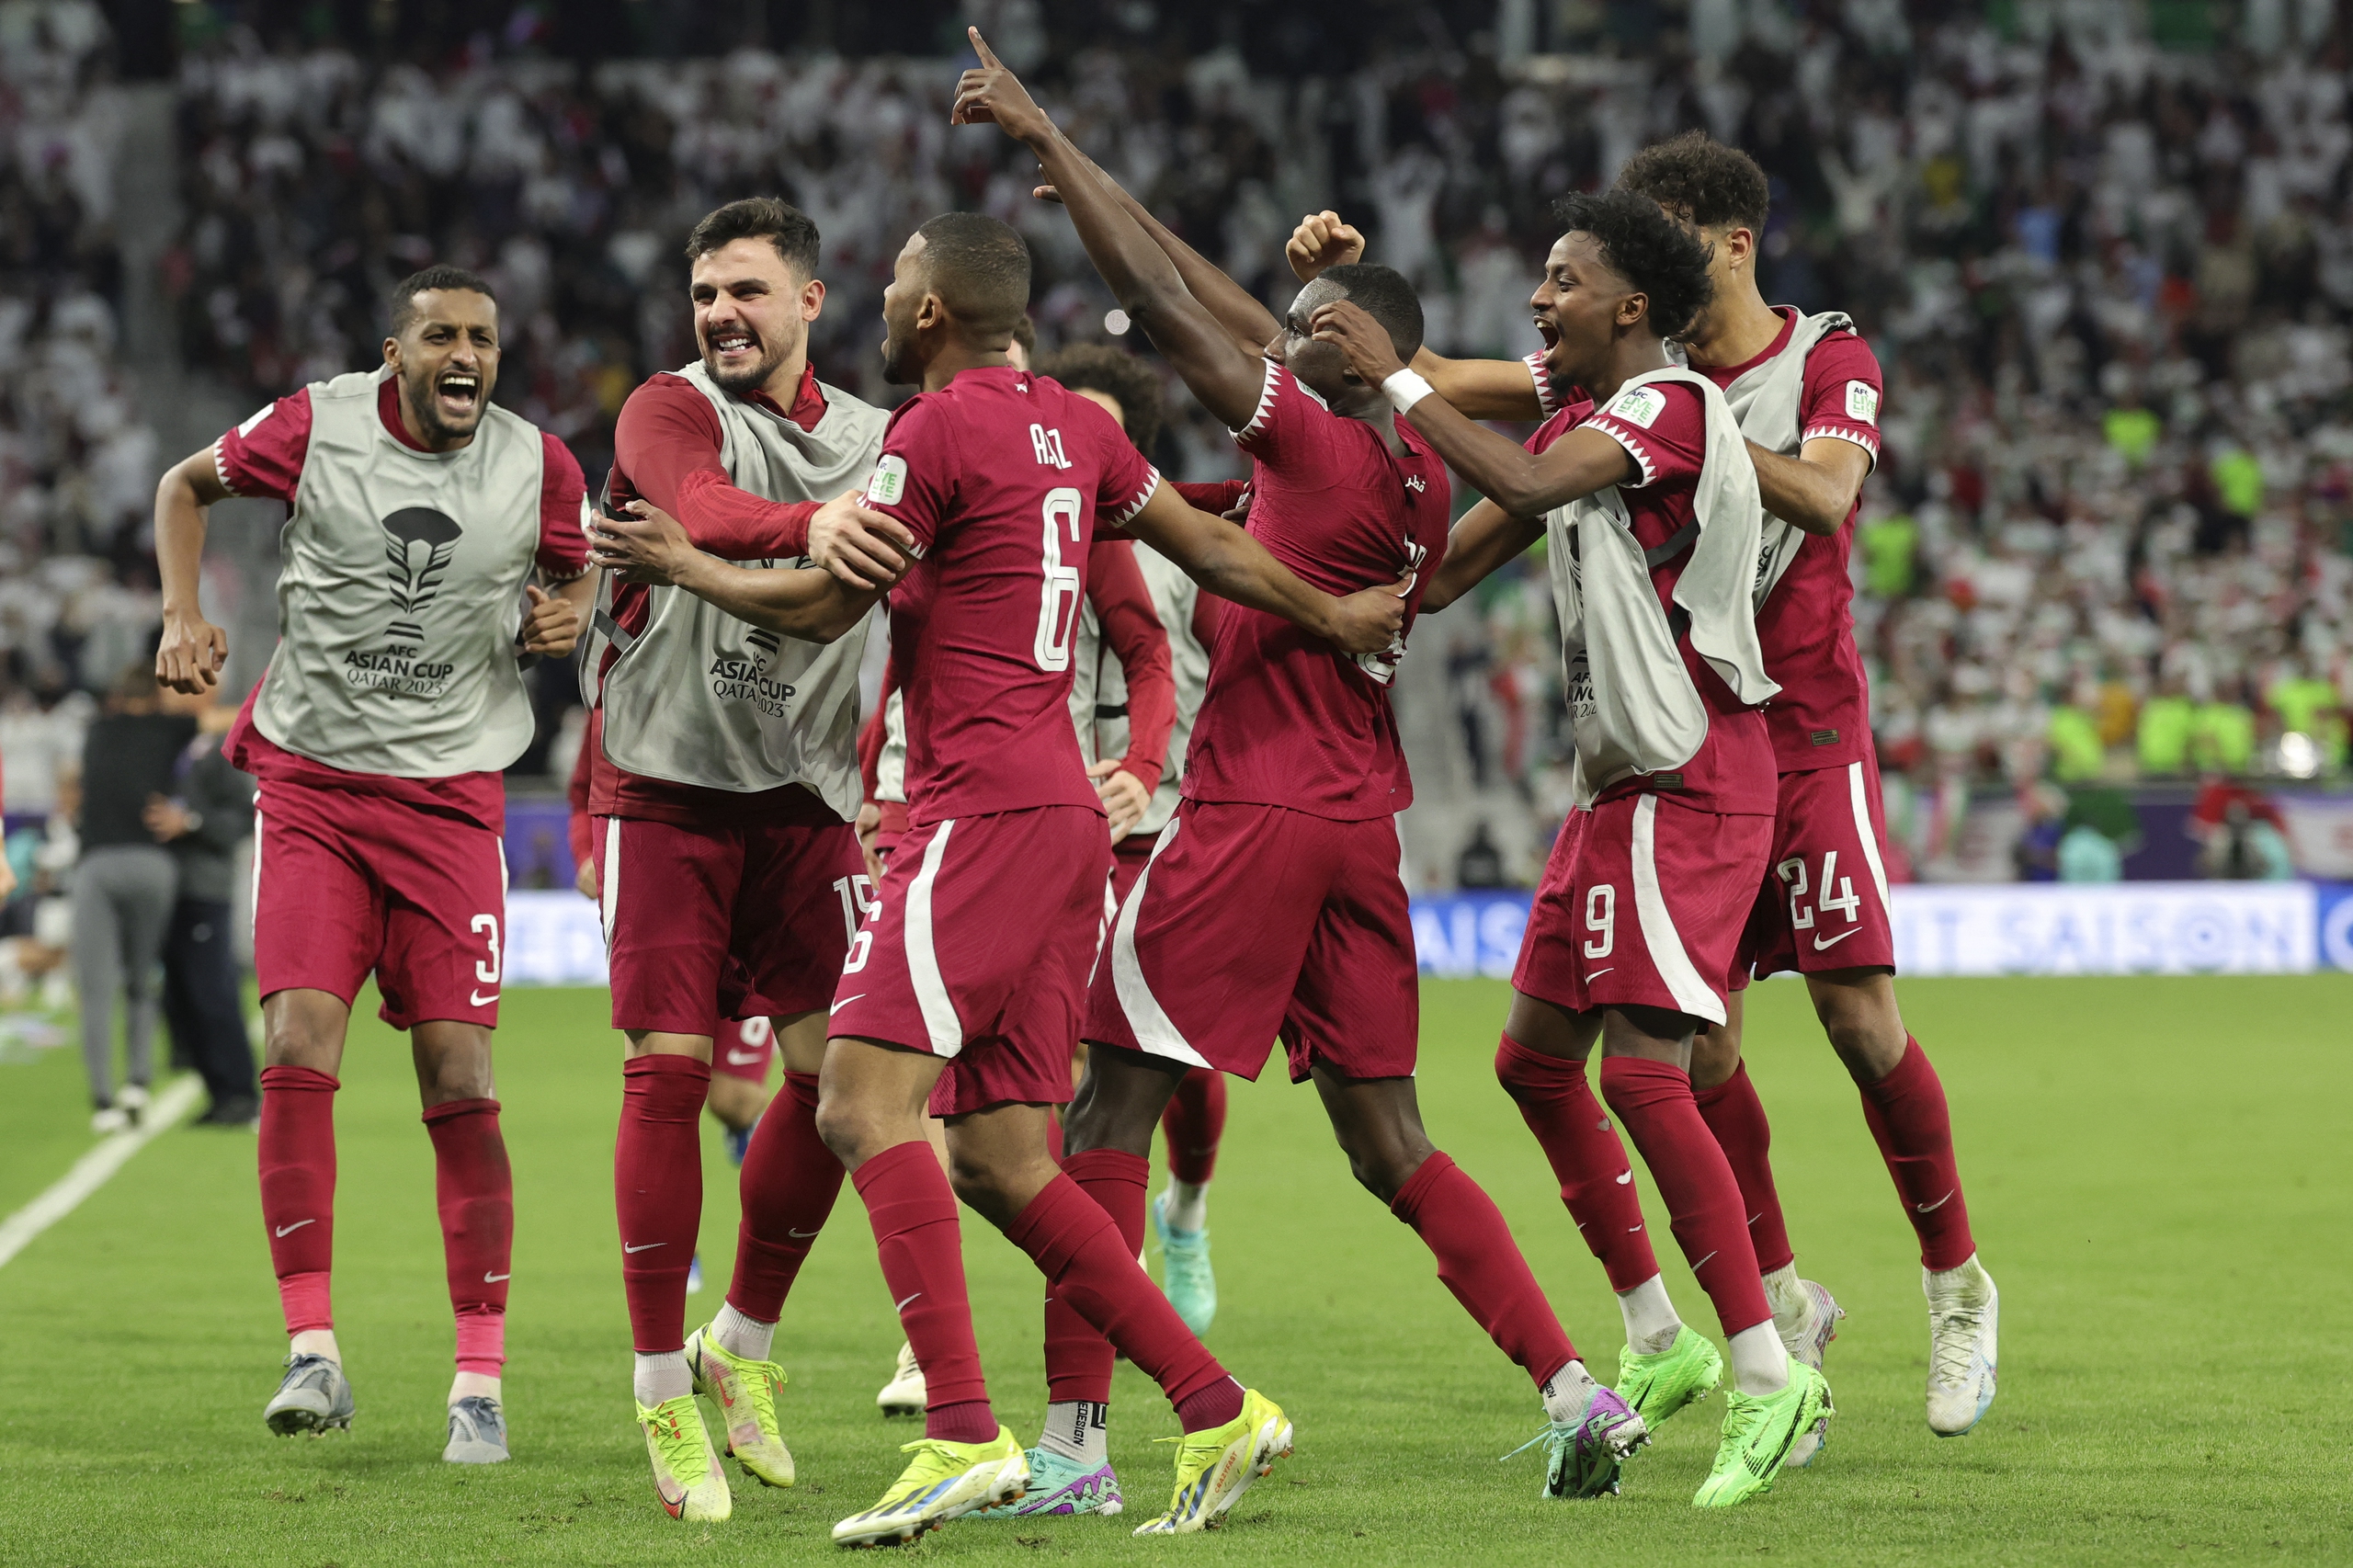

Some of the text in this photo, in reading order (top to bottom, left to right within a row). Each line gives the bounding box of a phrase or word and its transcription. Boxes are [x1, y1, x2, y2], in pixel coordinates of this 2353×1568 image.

[1630, 391, 1648, 400] AFC
[1033, 487, 1082, 672] 6
[344, 650, 454, 679] ASIAN CUP
[386, 644, 418, 659] AFC
[347, 668, 443, 695] QATAR 2023
[710, 658, 758, 686] ASIA
[758, 676, 797, 701] CUP
[713, 679, 757, 703] QATA
[1777, 850, 1861, 930] 24
[842, 900, 883, 975] 6
[1584, 883, 1617, 960] 9
[470, 913, 500, 983] 3
[1073, 1402, 1089, 1447] EDESIGN
[1214, 1450, 1239, 1494] CRAZYFAST
